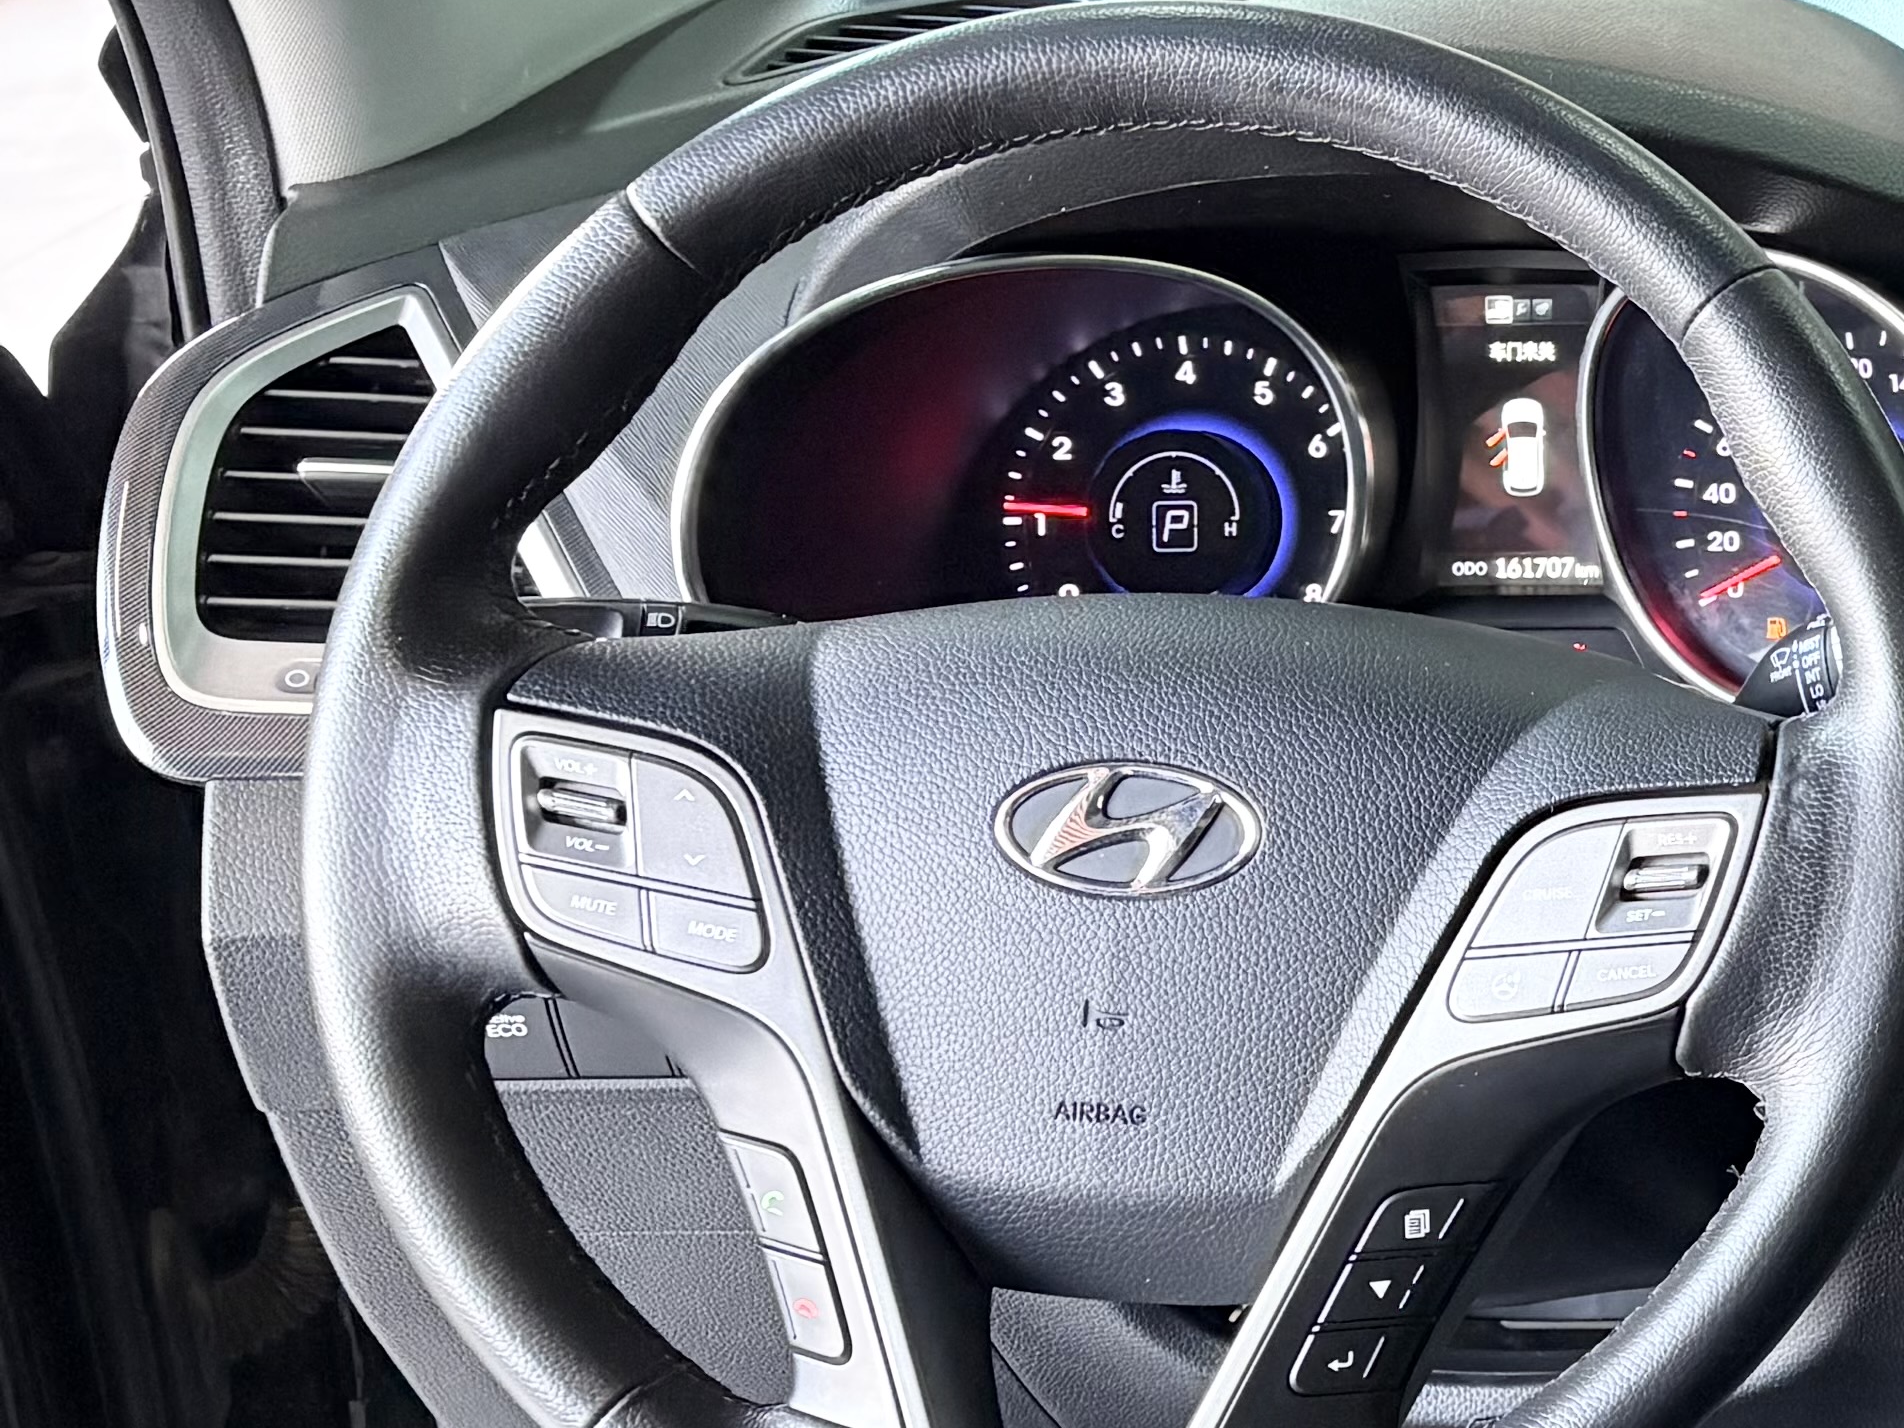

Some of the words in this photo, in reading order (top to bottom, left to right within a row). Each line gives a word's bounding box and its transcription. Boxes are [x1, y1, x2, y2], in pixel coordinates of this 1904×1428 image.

[1174, 360, 1197, 385] 4
[1103, 381, 1126, 407] 3
[1253, 380, 1275, 406] 5
[1051, 435, 1073, 461] 2
[1307, 434, 1329, 459] 6
[1702, 482, 1737, 505] 40
[1033, 512, 1047, 537] 1
[1111, 523, 1125, 539] C
[1162, 510, 1190, 543] P
[1224, 521, 1238, 537] H
[1327, 509, 1346, 534] 7
[1706, 531, 1741, 553] 20
[1451, 561, 1488, 577] ODO
[1494, 556, 1576, 580] 161707
[1801, 651, 1821, 669] OFF
[1810, 683, 1825, 700] LO
[569, 893, 618, 917] MUTE
[687, 920, 738, 944] MODE
[1596, 964, 1658, 982] CANCEL
[485, 1022, 529, 1038] ECO
[1054, 1099, 1147, 1126] AIRBAG
